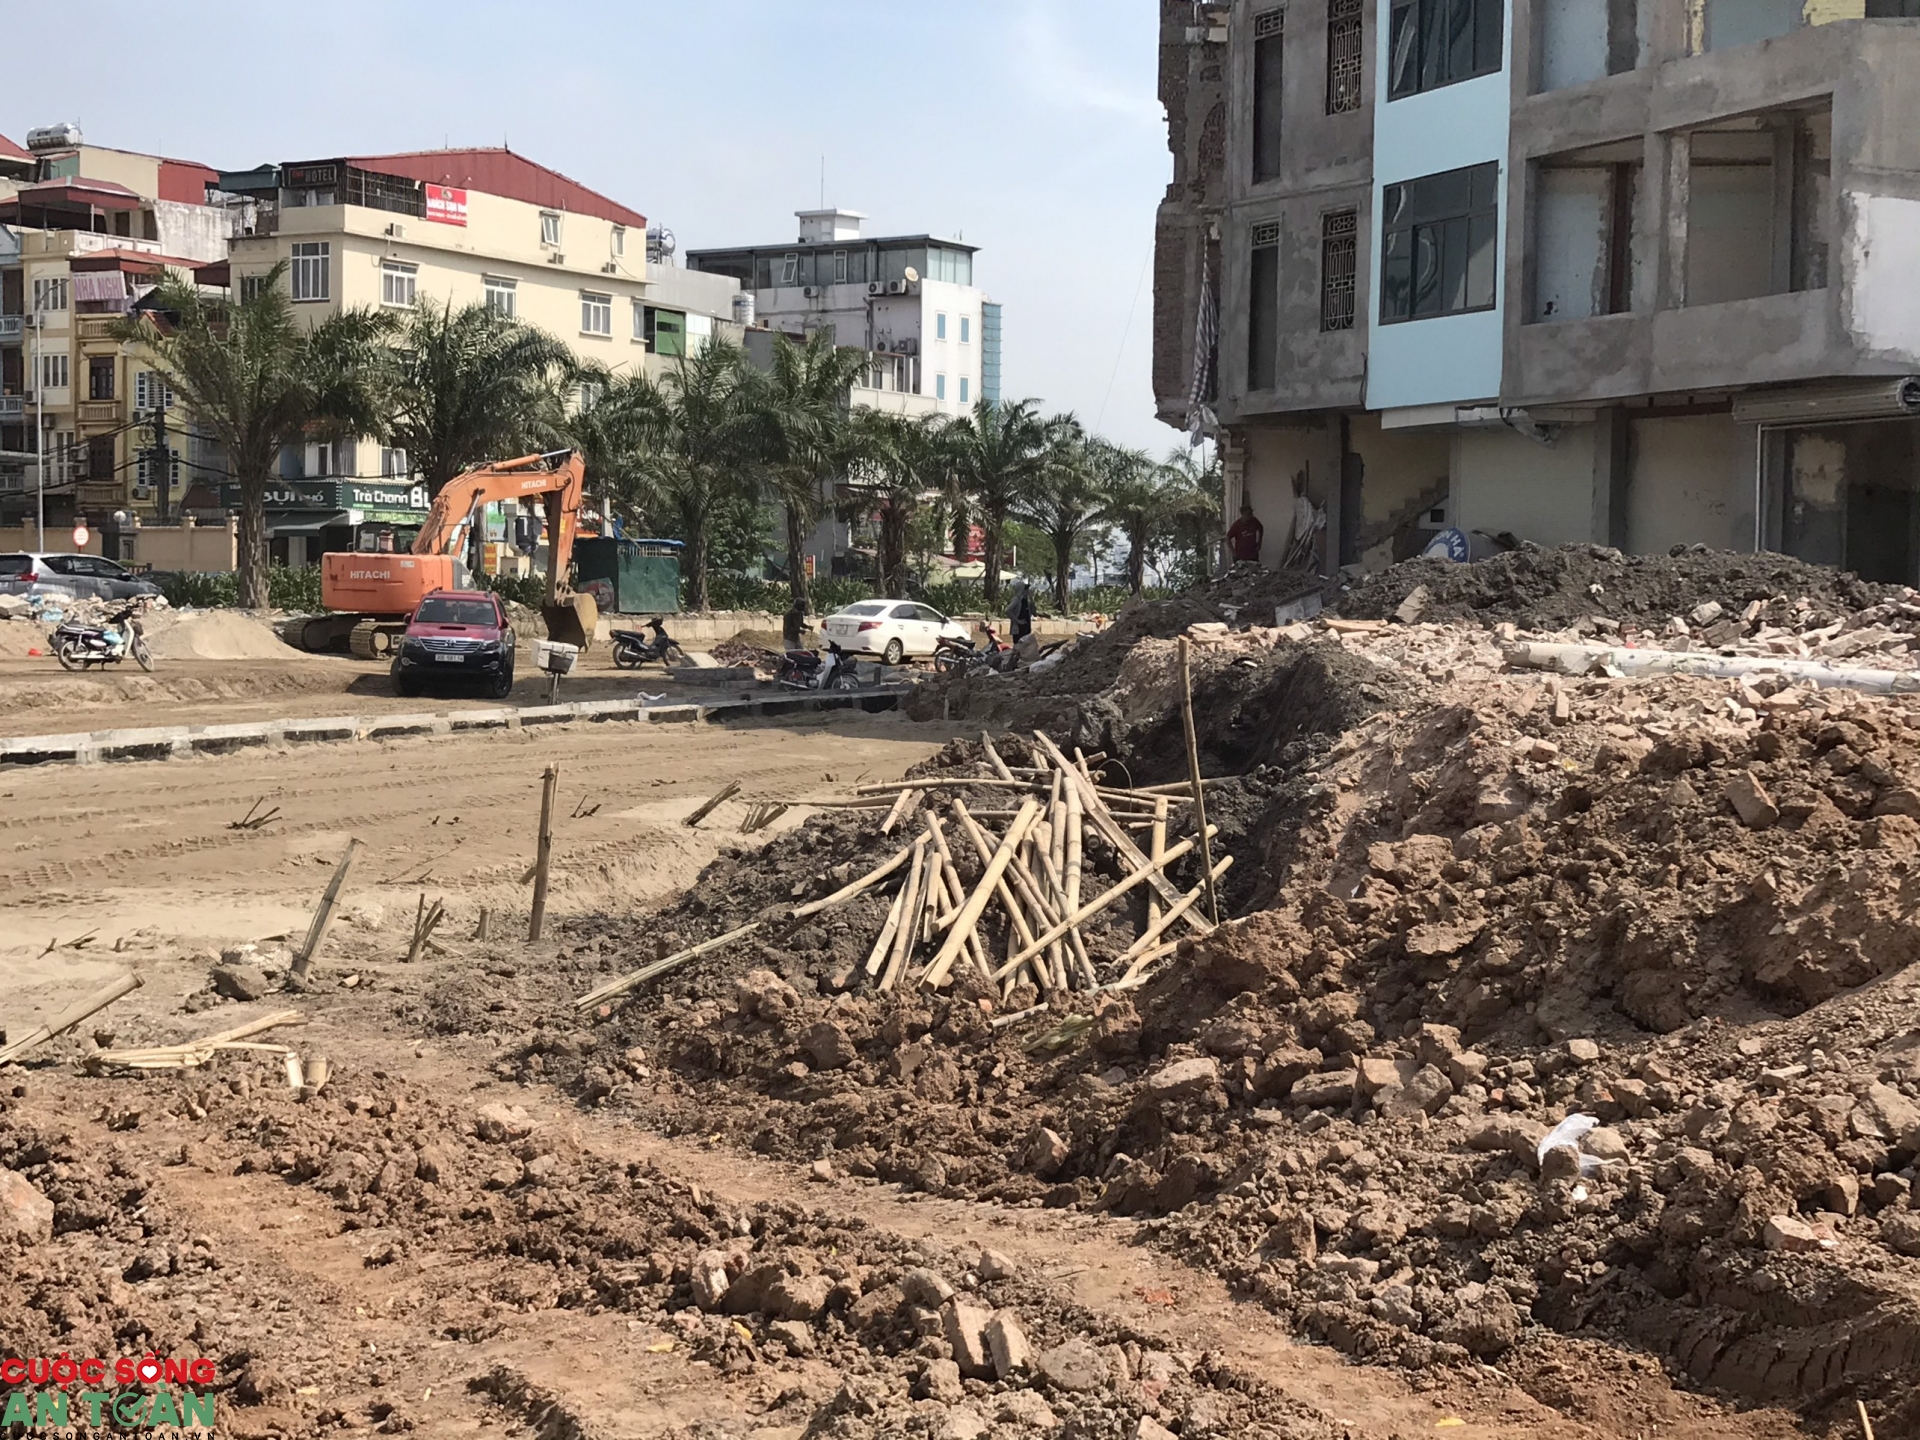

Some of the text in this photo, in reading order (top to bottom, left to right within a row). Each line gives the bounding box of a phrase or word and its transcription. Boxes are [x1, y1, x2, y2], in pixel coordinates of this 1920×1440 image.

[305, 169, 333, 182] HOTEL
[521, 479, 547, 490] HITACHI
[350, 570, 390, 579] HITACHI
